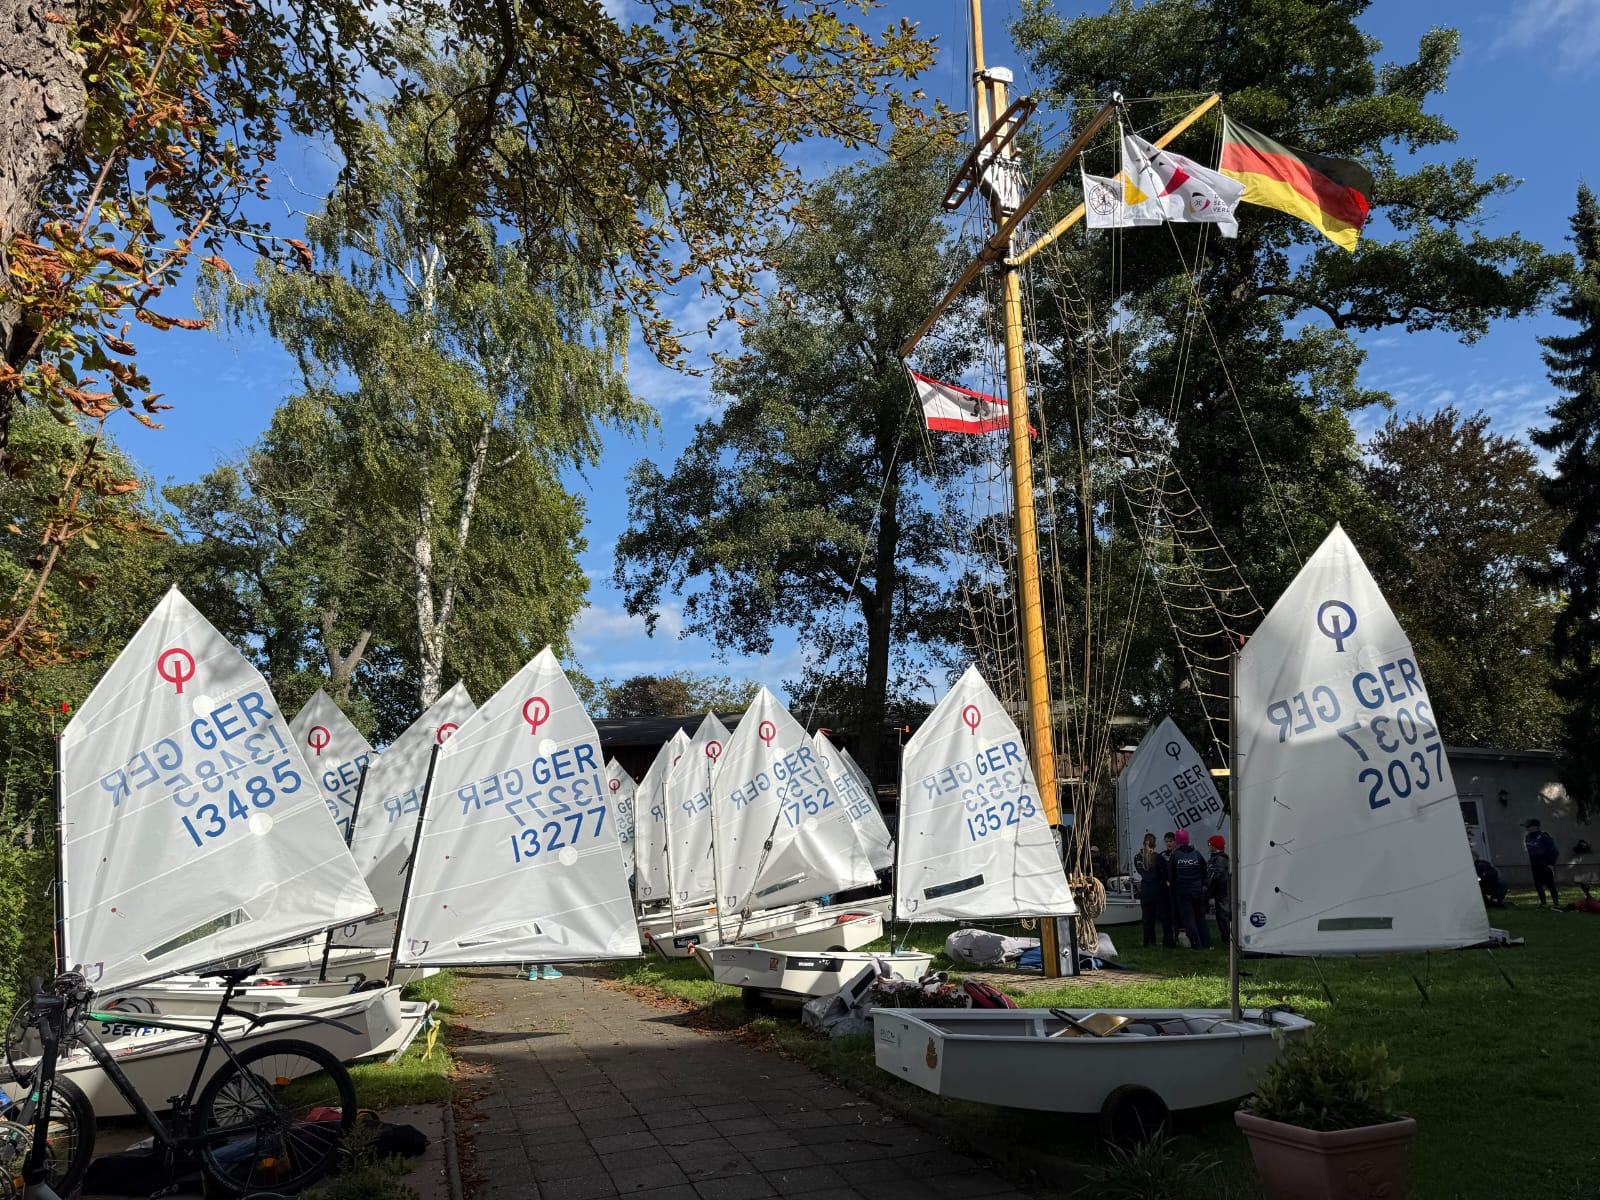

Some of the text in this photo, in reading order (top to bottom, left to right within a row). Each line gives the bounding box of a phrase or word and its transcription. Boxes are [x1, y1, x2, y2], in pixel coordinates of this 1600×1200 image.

[1352, 657, 1423, 709] GER
[190, 691, 274, 750] GER
[532, 743, 598, 785] GER
[773, 746, 816, 781] GER
[975, 741, 1023, 775] GER
[1172, 764, 1206, 790] GER
[1358, 741, 1443, 810] 2037
[181, 758, 301, 847] 13485
[783, 787, 835, 828] 1752
[967, 795, 1036, 841] 13523
[1173, 796, 1220, 830] 10848
[511, 805, 607, 863] 13277
